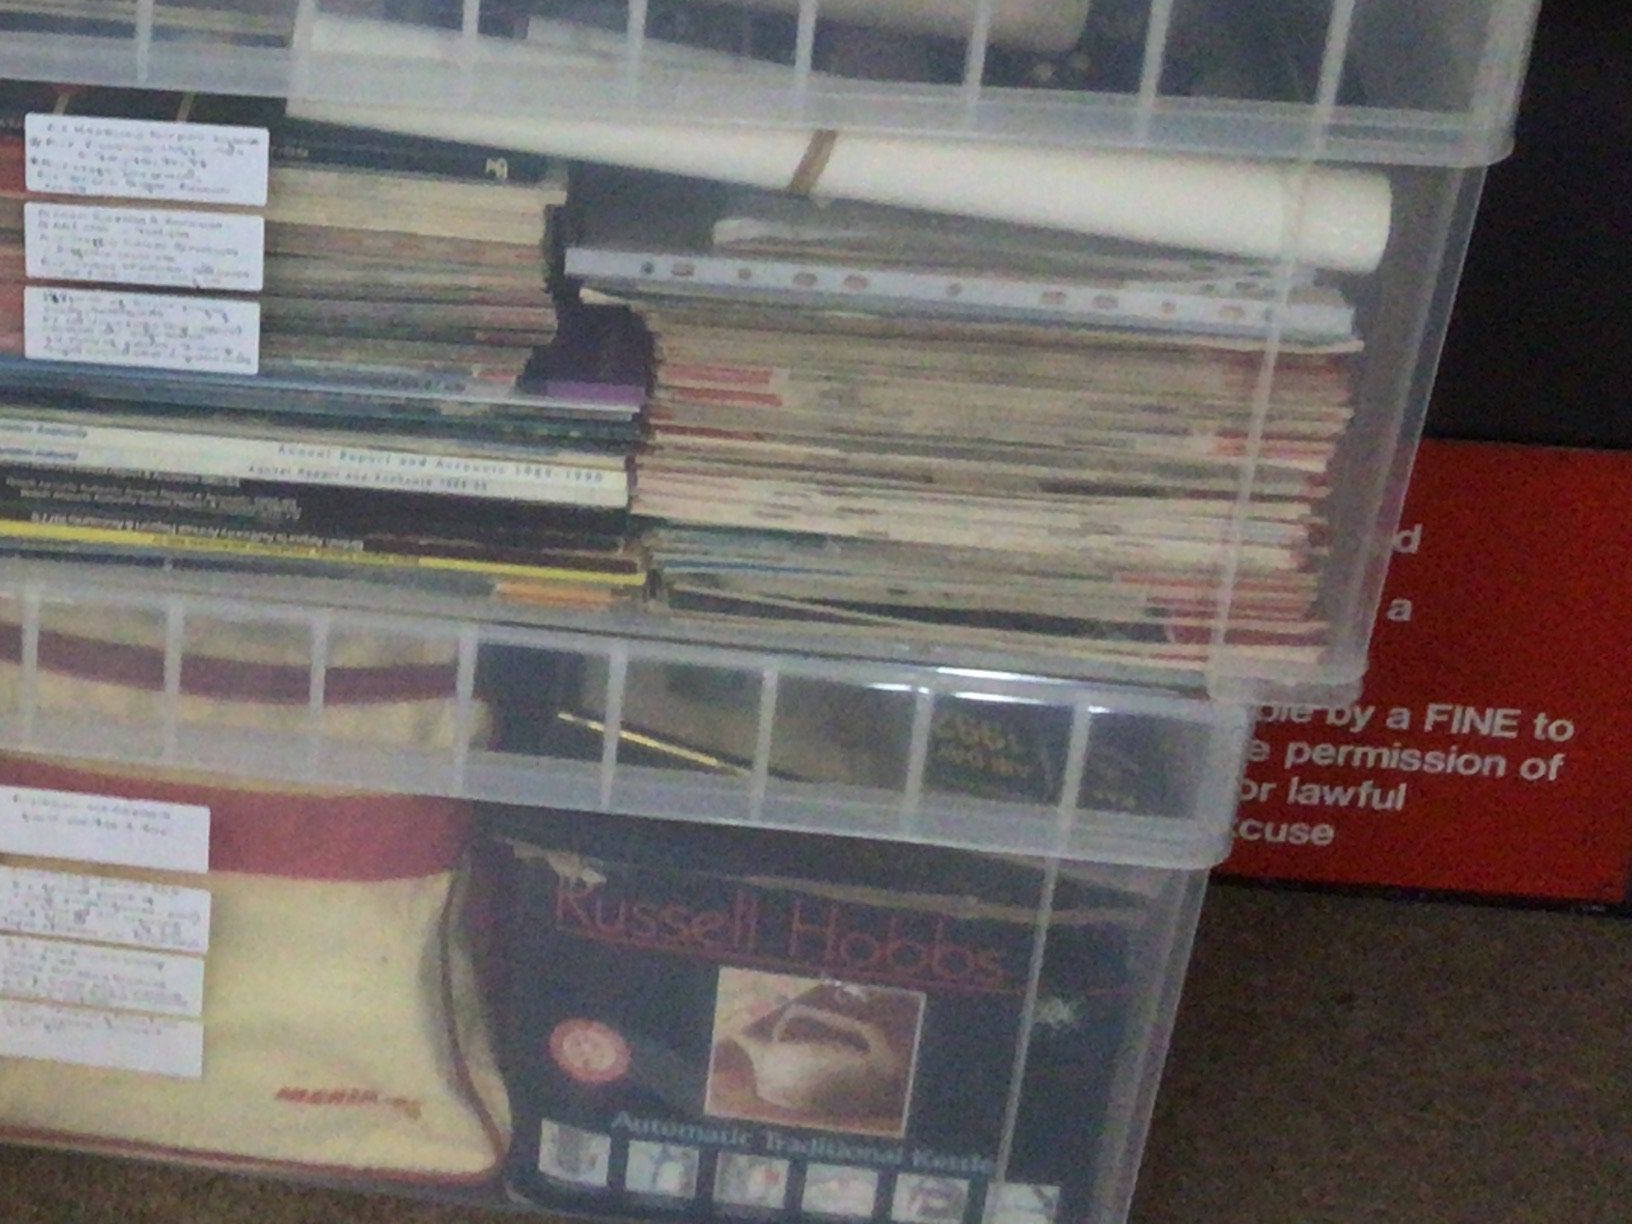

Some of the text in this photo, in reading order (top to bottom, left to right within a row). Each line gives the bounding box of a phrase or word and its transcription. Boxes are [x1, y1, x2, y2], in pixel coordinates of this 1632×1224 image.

[1326, 704, 1375, 733] by
[1386, 707, 1411, 730] a
[1424, 703, 1522, 739] FINE
[1533, 712, 1575, 742] to
[1284, 741, 1506, 777] permission
[1520, 753, 1566, 781] of
[1287, 776, 1408, 811] lawful
[552, 884, 1008, 980] Russell Hobbs
[610, 1110, 755, 1146] Automatic
[764, 1129, 906, 1166] Traditional
